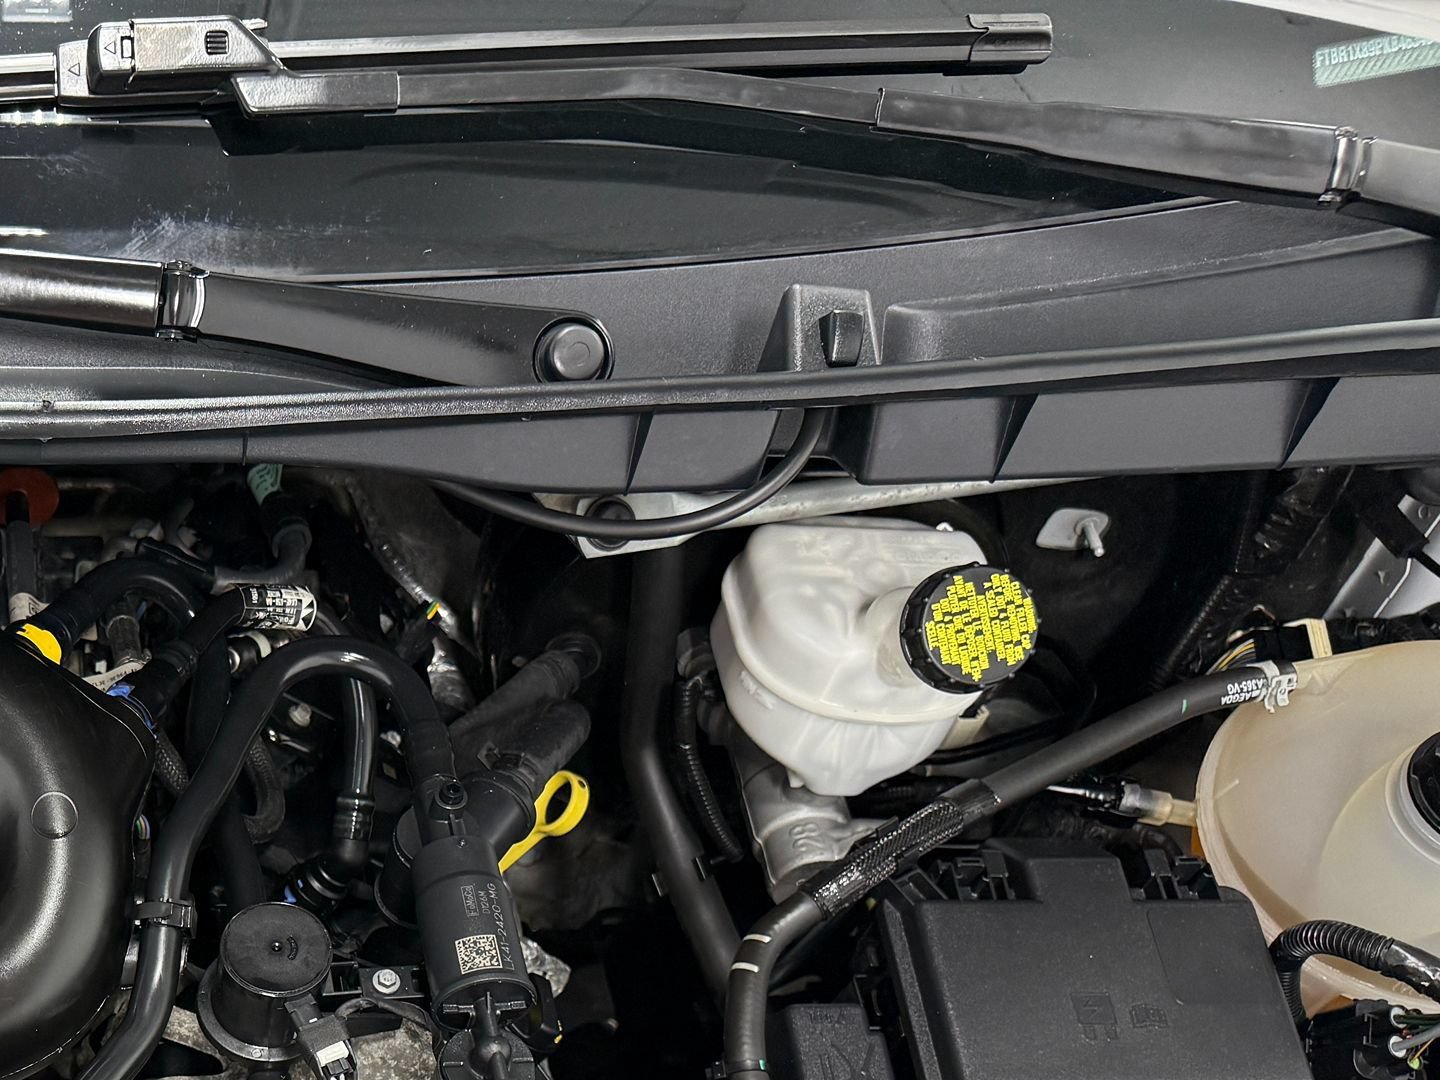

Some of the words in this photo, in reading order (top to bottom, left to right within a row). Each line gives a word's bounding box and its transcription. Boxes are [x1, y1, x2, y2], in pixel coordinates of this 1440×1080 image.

[953, 575, 966, 598] AVANT
[991, 574, 1002, 593] ONLY
[1011, 581, 1023, 605] CLEAN
[940, 598, 951, 613] DOT
[959, 600, 969, 611] DE
[965, 582, 980, 618] NETTOYER
[986, 590, 998, 618] SEALED
[996, 595, 1006, 610] DOT
[962, 613, 972, 624] LE
[972, 621, 982, 631] LE
[1000, 574, 1013, 602] BEFORE
[1014, 645, 1025, 660] USE
[1016, 607, 1028, 632] FILLER
[946, 585, 960, 614] PLOYER
[953, 615, 964, 631] QUE
[959, 645, 971, 675] LIQUIDE
[1001, 620, 1012, 642] FLUID
[975, 635, 990, 670] BOUCHON
[1021, 634, 1032, 649] CAP
[1005, 644, 1017, 666] FROM
[463, 886, 478, 916] FoMoCo
